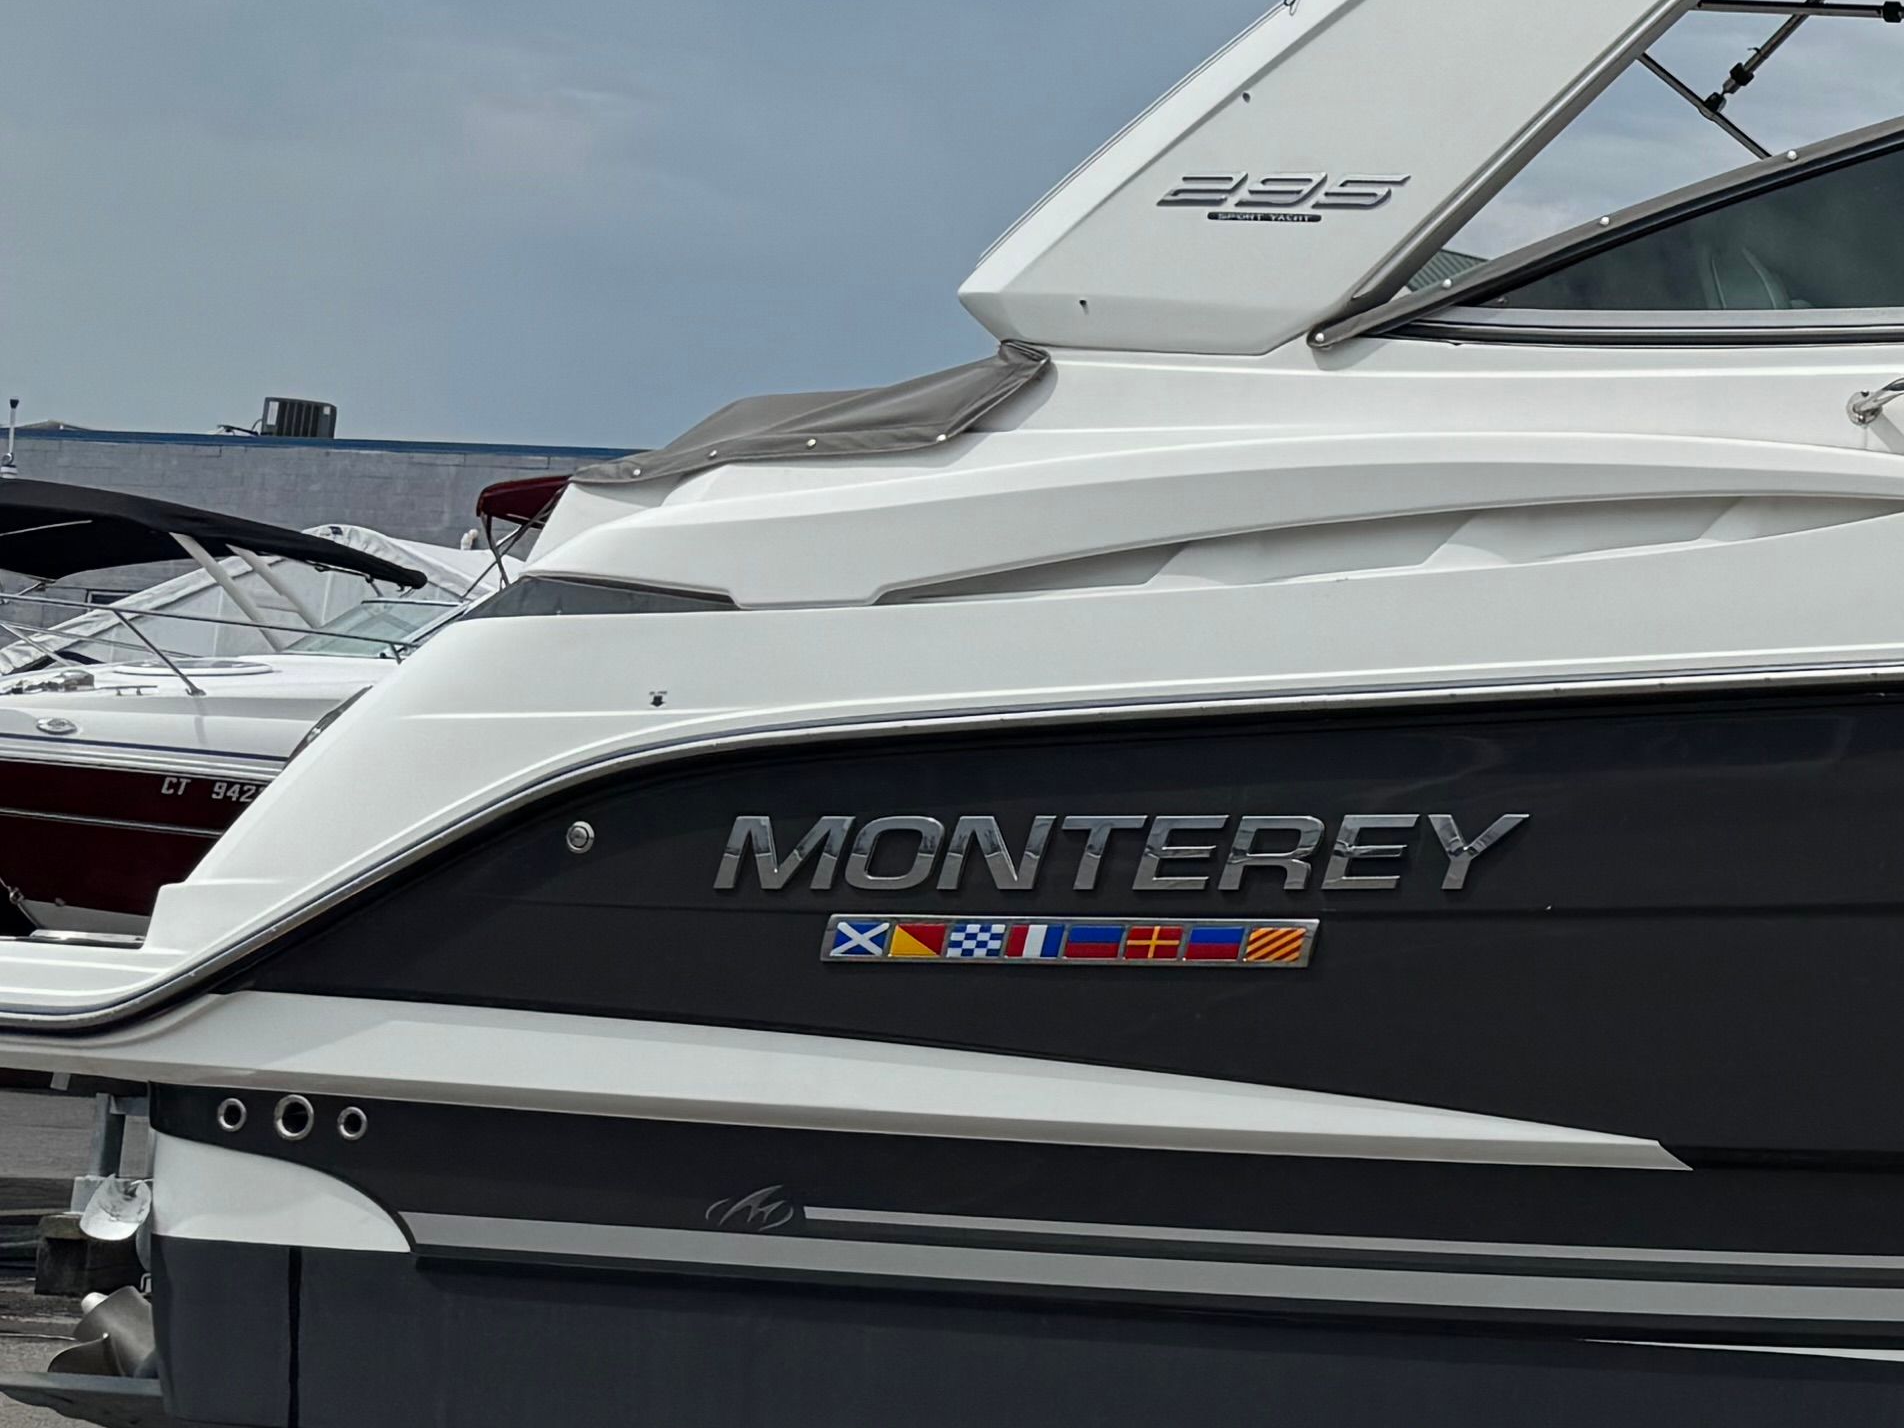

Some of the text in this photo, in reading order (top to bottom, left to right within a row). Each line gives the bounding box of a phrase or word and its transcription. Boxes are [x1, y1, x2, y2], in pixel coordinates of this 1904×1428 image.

[1156, 172, 1411, 209] 295
[1218, 212, 1310, 222] SPORT YACHT
[161, 776, 192, 795] CT
[713, 814, 1530, 891] MONTEREY
